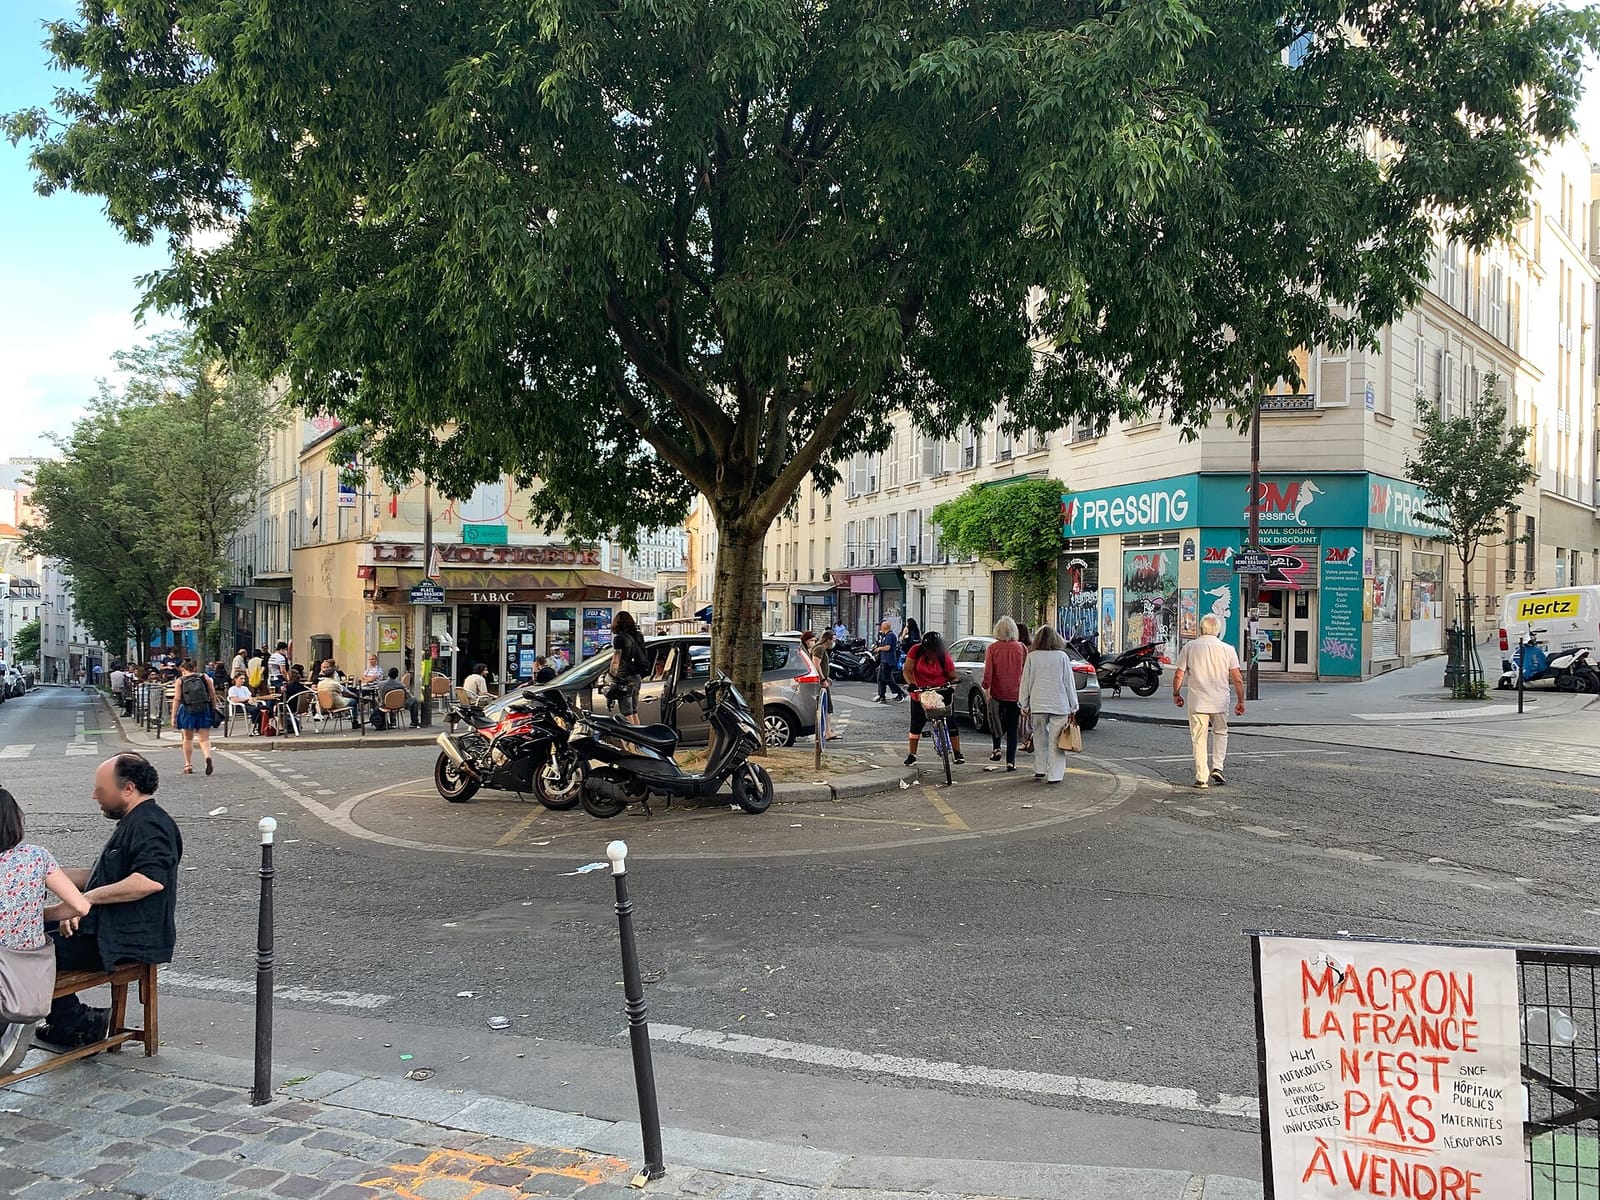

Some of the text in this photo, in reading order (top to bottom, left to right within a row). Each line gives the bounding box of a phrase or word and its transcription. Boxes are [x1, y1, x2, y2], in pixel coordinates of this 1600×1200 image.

[1244, 482, 1299, 512] 2M
[1371, 484, 1387, 514] 2M
[1061, 501, 1074, 525] M
[1282, 527, 1315, 535] SOIGNE
[373, 544, 600, 566] LE VOLTIGEUR
[1202, 547, 1227, 561] 2M
[1324, 547, 1350, 561] 2M
[471, 593, 515, 602] TABAC
[607, 590, 622, 599] LE
[1522, 600, 1571, 616] Hertz
[1301, 960, 1474, 1017] MACRON
[1302, 1006, 1480, 1053] LA FRANCE
[1289, 1047, 1316, 1062] HLM
[1339, 1047, 1450, 1094] N'EST
[1459, 1065, 1488, 1076] SNCF
[1282, 1081, 1326, 1097] BARRAGES
[1453, 1079, 1504, 1100] HÔPITAUX
[1452, 1093, 1494, 1111] PUBLICS
[1344, 1089, 1436, 1144] PAS
[1440, 1112, 1503, 1130] MATERNITÉS
[1302, 1136, 1483, 1200] À VENDRE
